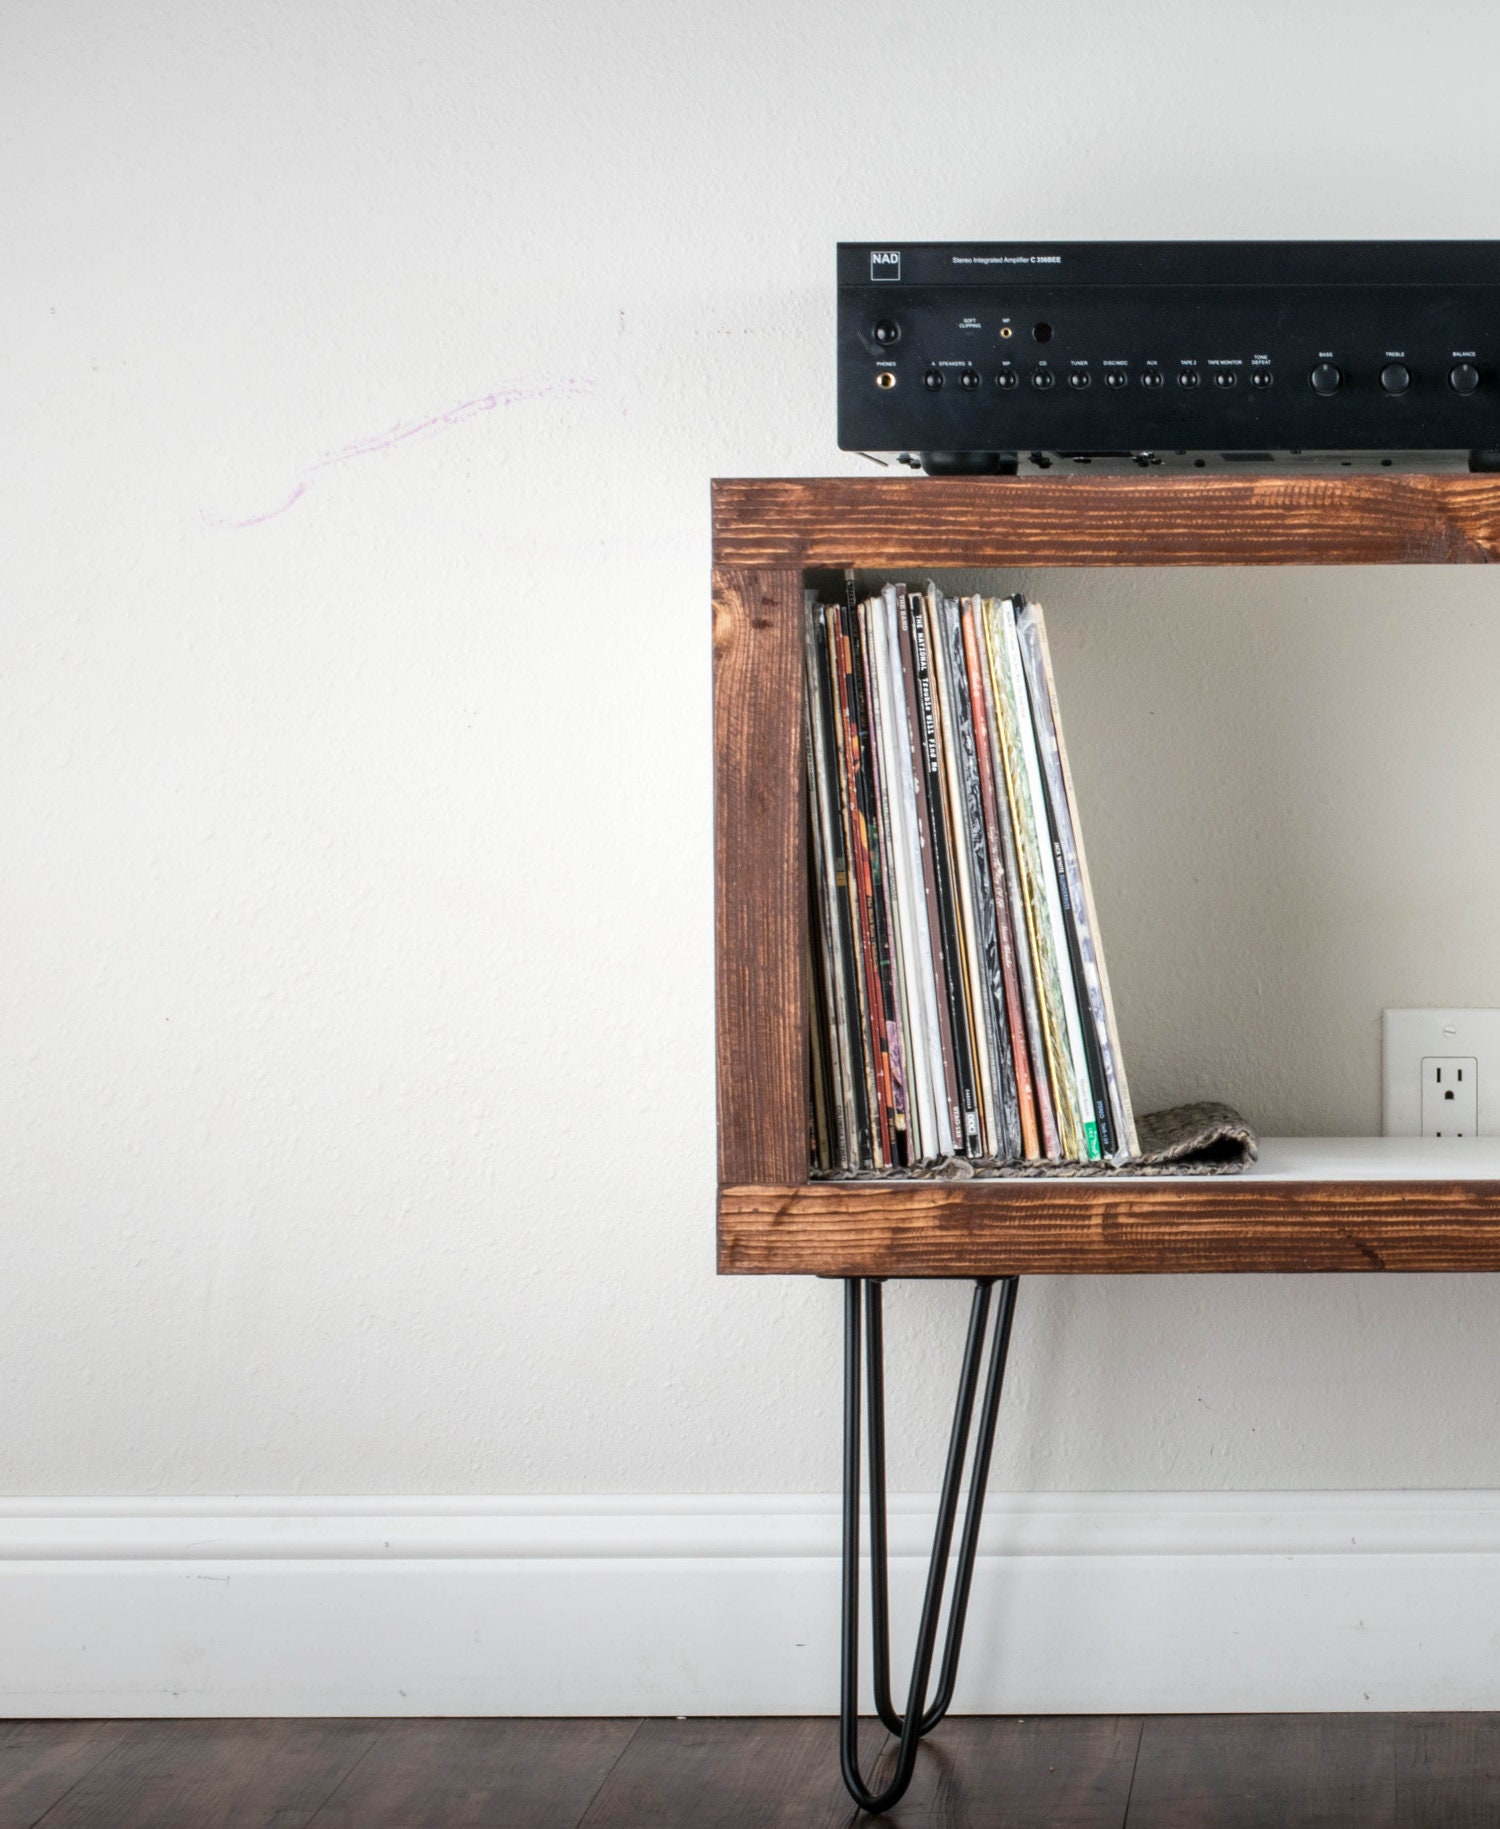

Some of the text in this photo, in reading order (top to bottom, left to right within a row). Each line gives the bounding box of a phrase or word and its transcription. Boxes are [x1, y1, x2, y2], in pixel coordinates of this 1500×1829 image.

[872, 253, 899, 264] NAD
[952, 256, 972, 264] Stereo
[973, 256, 1003, 265] Integrated
[1003, 256, 1029, 265] Amplifier
[1030, 256, 1036, 264] C
[915, 614, 927, 670] THE NATIONAL
[922, 678, 938, 772] Trouble Will Find Me
[1053, 842, 1061, 854] JACK
[1055, 855, 1064, 872] WHITE
[1096, 1100, 1105, 1118] STEREO
